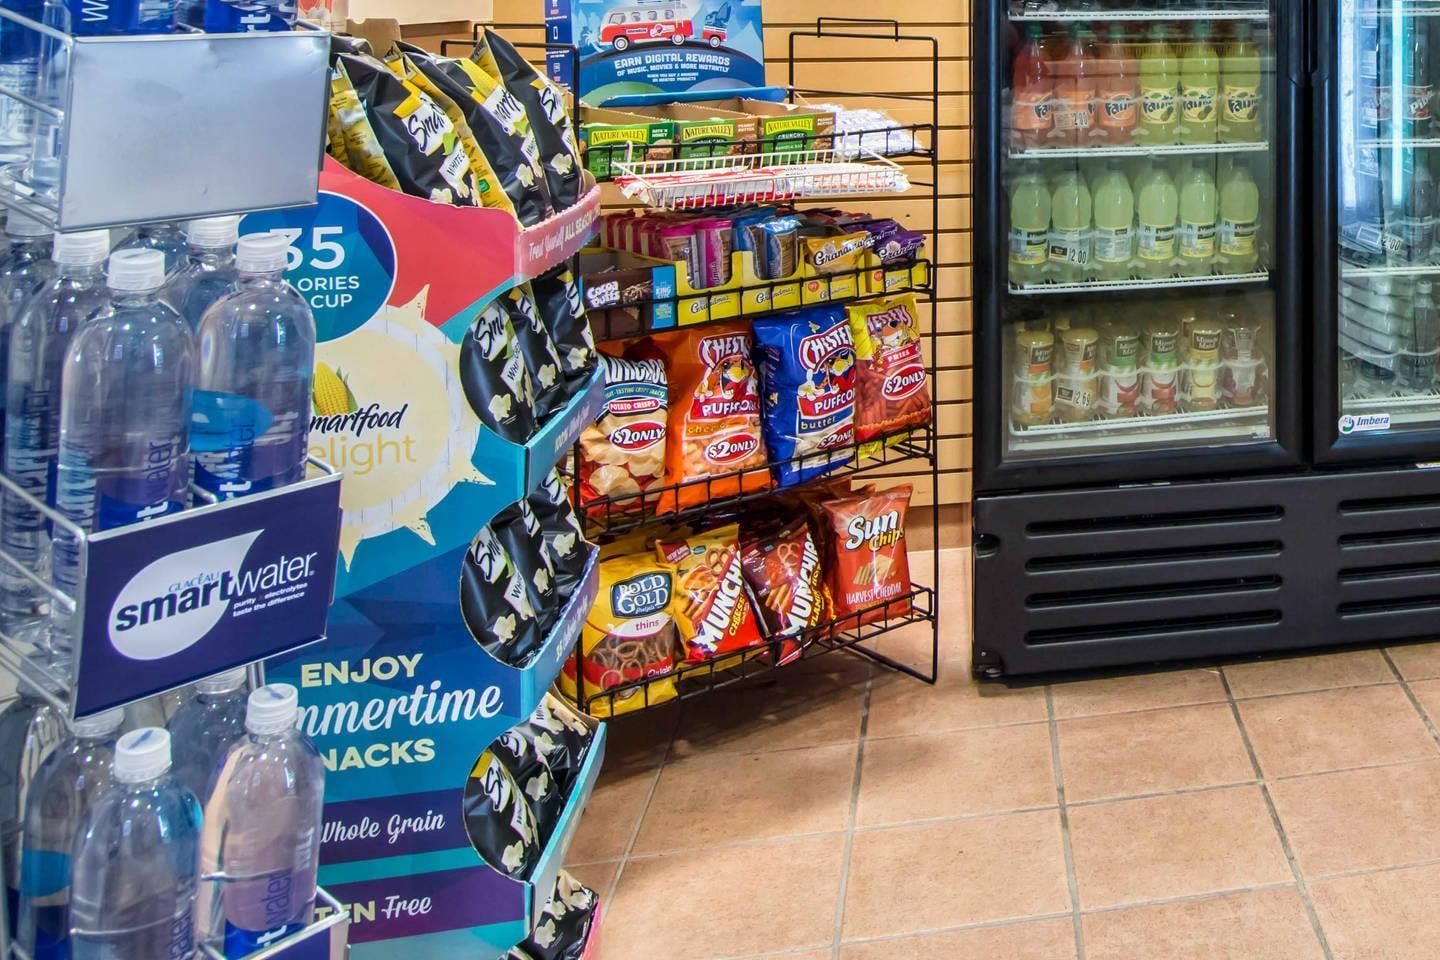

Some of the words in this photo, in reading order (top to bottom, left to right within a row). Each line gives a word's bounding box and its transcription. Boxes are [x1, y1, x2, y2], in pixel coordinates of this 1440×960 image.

[614, 56, 642, 69] EARN
[645, 53, 683, 64] DIGITAL
[685, 53, 731, 66] REWARDS
[650, 63, 673, 71] MOVIES
[685, 127, 709, 139] NATURE
[708, 125, 732, 135] VALLEY
[767, 122, 790, 135] NATURE
[790, 119, 813, 131] VALLEY
[592, 130, 621, 144] NATURE
[621, 129, 645, 140] VALLEY
[298, 276, 359, 292] ORIES
[310, 294, 353, 310] CUP
[903, 370, 925, 387] ONLY
[310, 403, 408, 437] martfood
[1356, 416, 1390, 426] Imbera
[631, 428, 665, 441] ONLY
[730, 438, 757, 452] ONLY
[309, 433, 417, 475] elight
[846, 510, 899, 550] Sun
[618, 587, 669, 616] GOLD
[692, 551, 742, 653] MUNCHI
[845, 588, 874, 605] HARVEST
[635, 619, 660, 631] thins
[301, 653, 423, 688] ENJOY
[298, 679, 504, 738] mmertime
[320, 738, 436, 772] NACKS
[320, 816, 381, 844] Whole
[387, 810, 446, 845] Grain
[381, 895, 432, 921] Free
